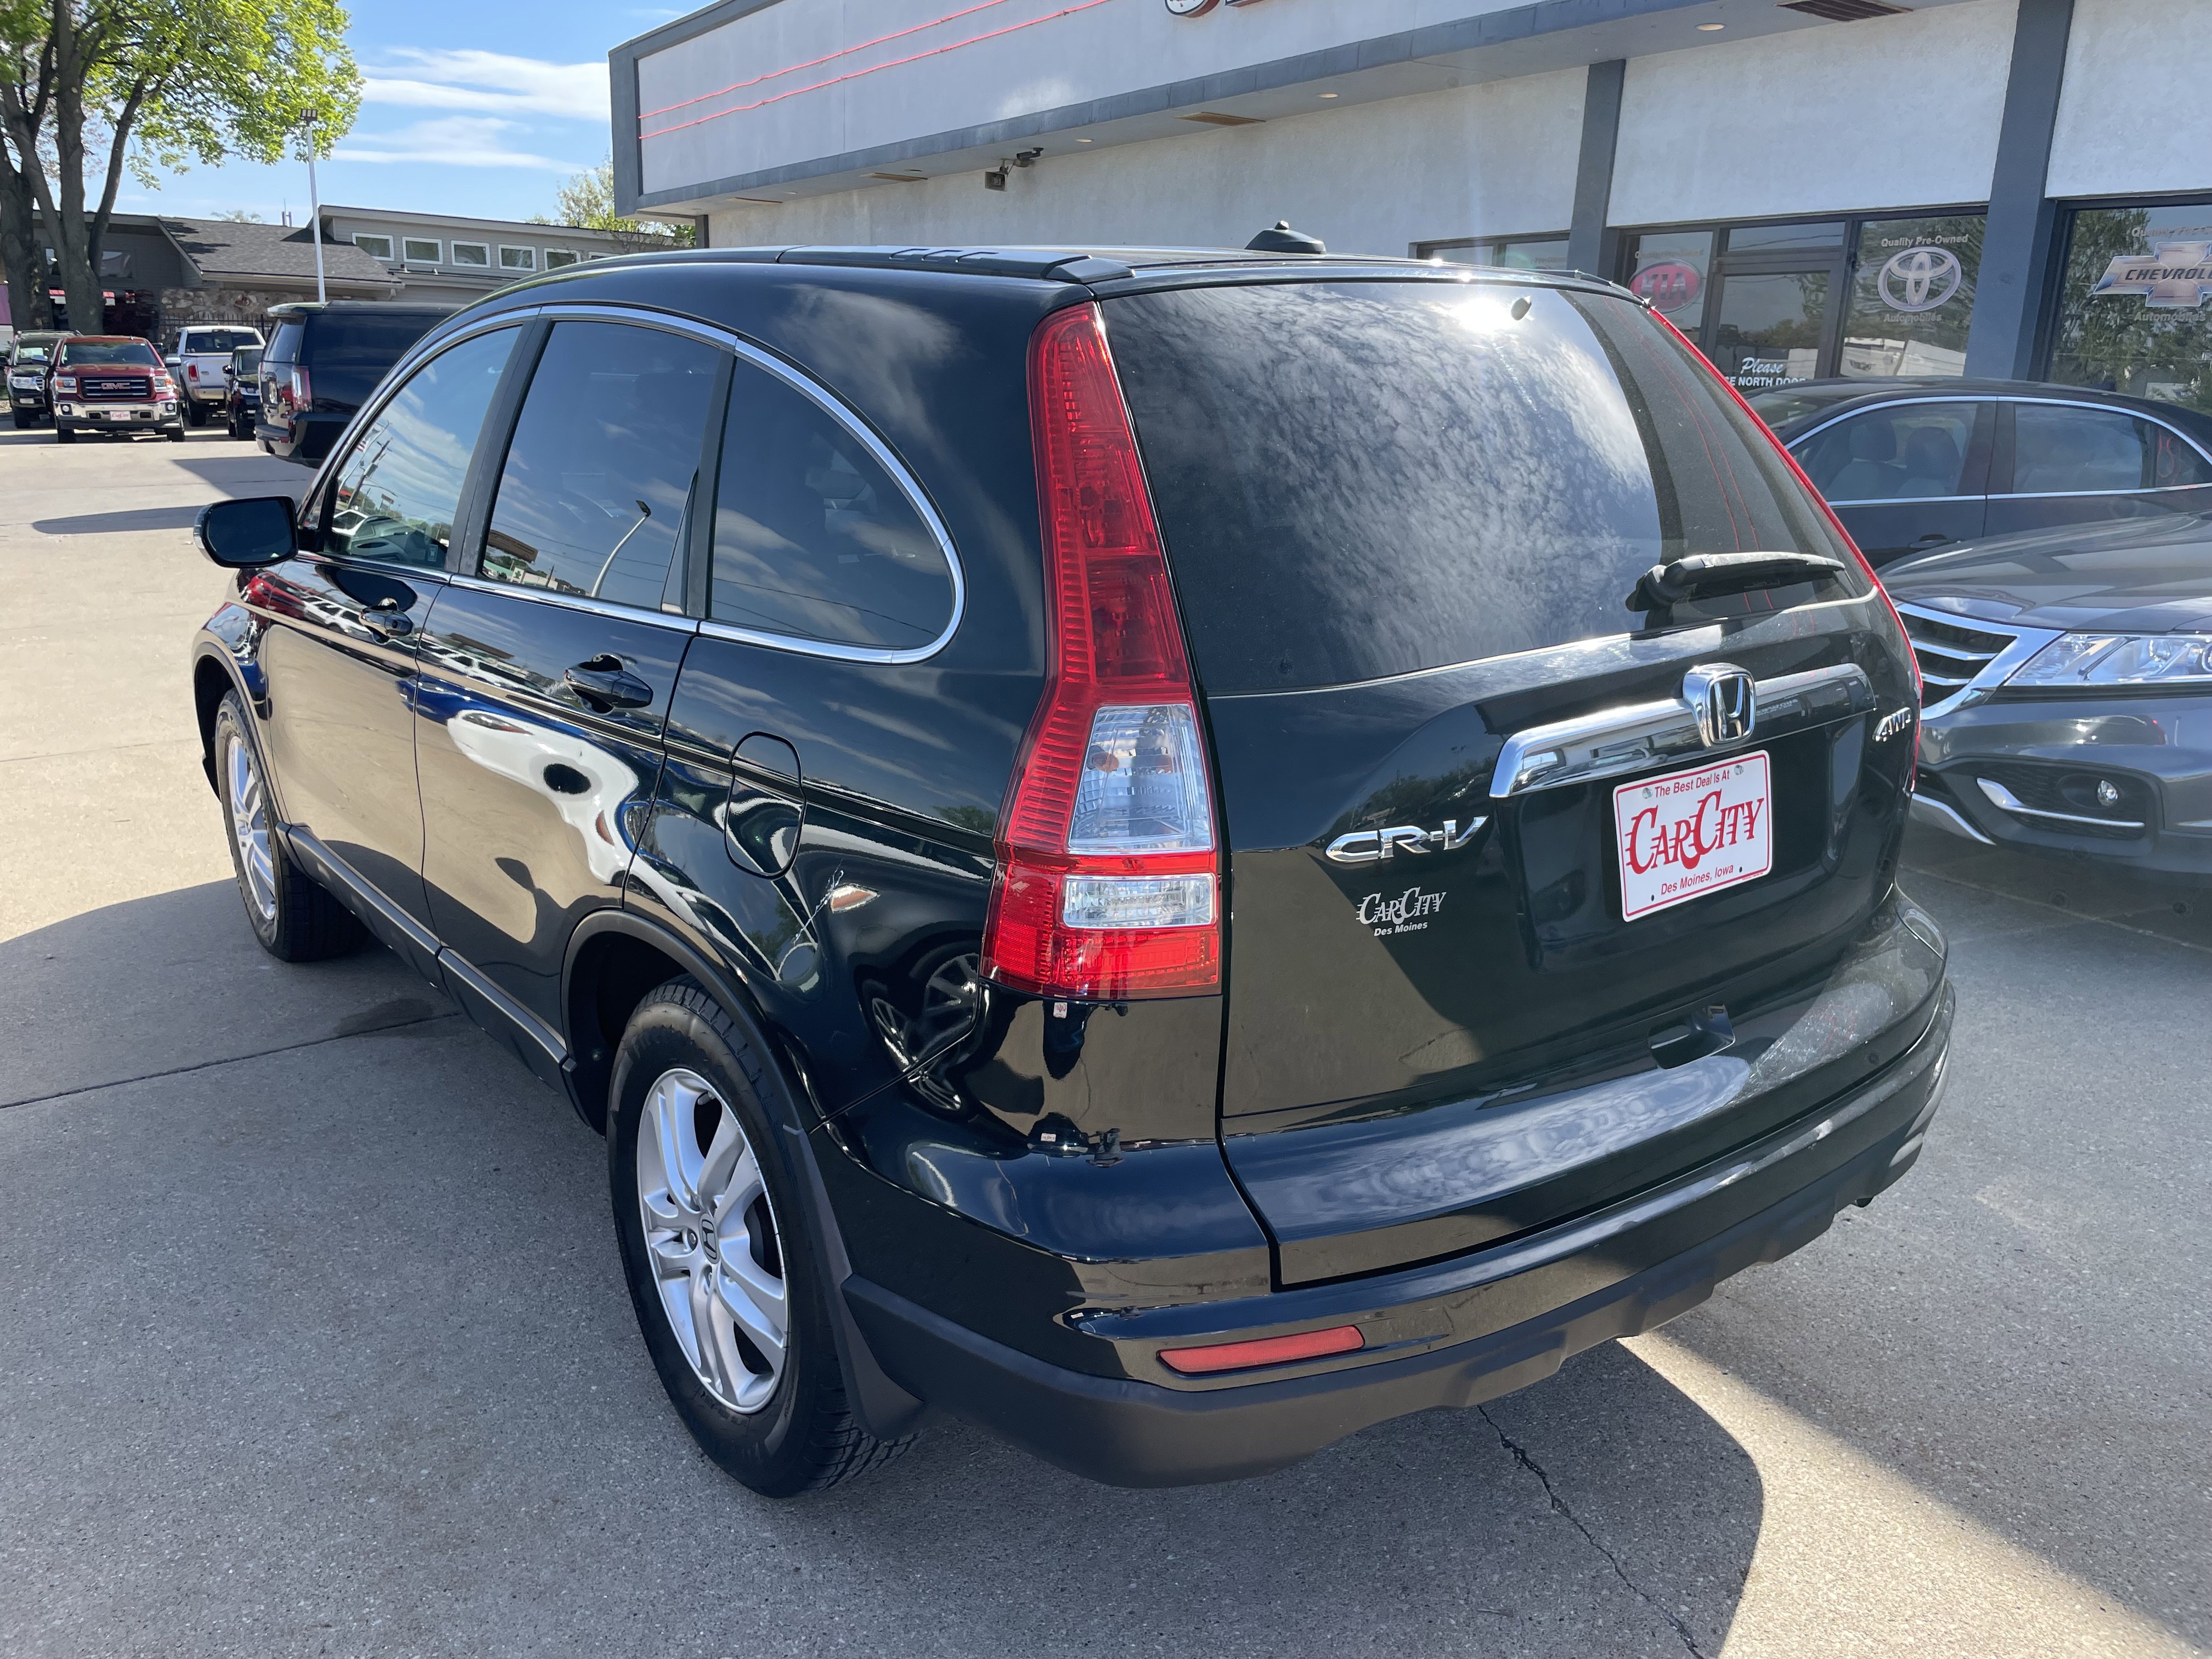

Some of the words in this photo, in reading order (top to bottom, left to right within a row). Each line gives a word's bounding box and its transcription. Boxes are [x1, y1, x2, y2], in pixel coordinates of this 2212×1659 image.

[1881, 237, 1913, 247] Quality
[1915, 234, 1968, 245] Pre-Owned
[1641, 272, 1686, 300] KIA
[1883, 313, 1942, 324] Automobiles
[2134, 312, 2206, 322] Automobiles
[1740, 357, 1784, 374] Please
[1739, 376, 1774, 387] NORTH
[1655, 785, 1671, 798] The
[1673, 781, 1694, 794] Best
[1696, 774, 1712, 789] Deal
[1714, 772, 1720, 783] Is
[1722, 769, 1730, 781] At
[1325, 815, 1489, 864] CR-V
[1661, 882, 1678, 896] Des
[1680, 871, 1712, 889] Moines,
[1715, 864, 1734, 878] Iowa
[1374, 927, 1392, 936] Des
[1395, 921, 1428, 933] Moines
